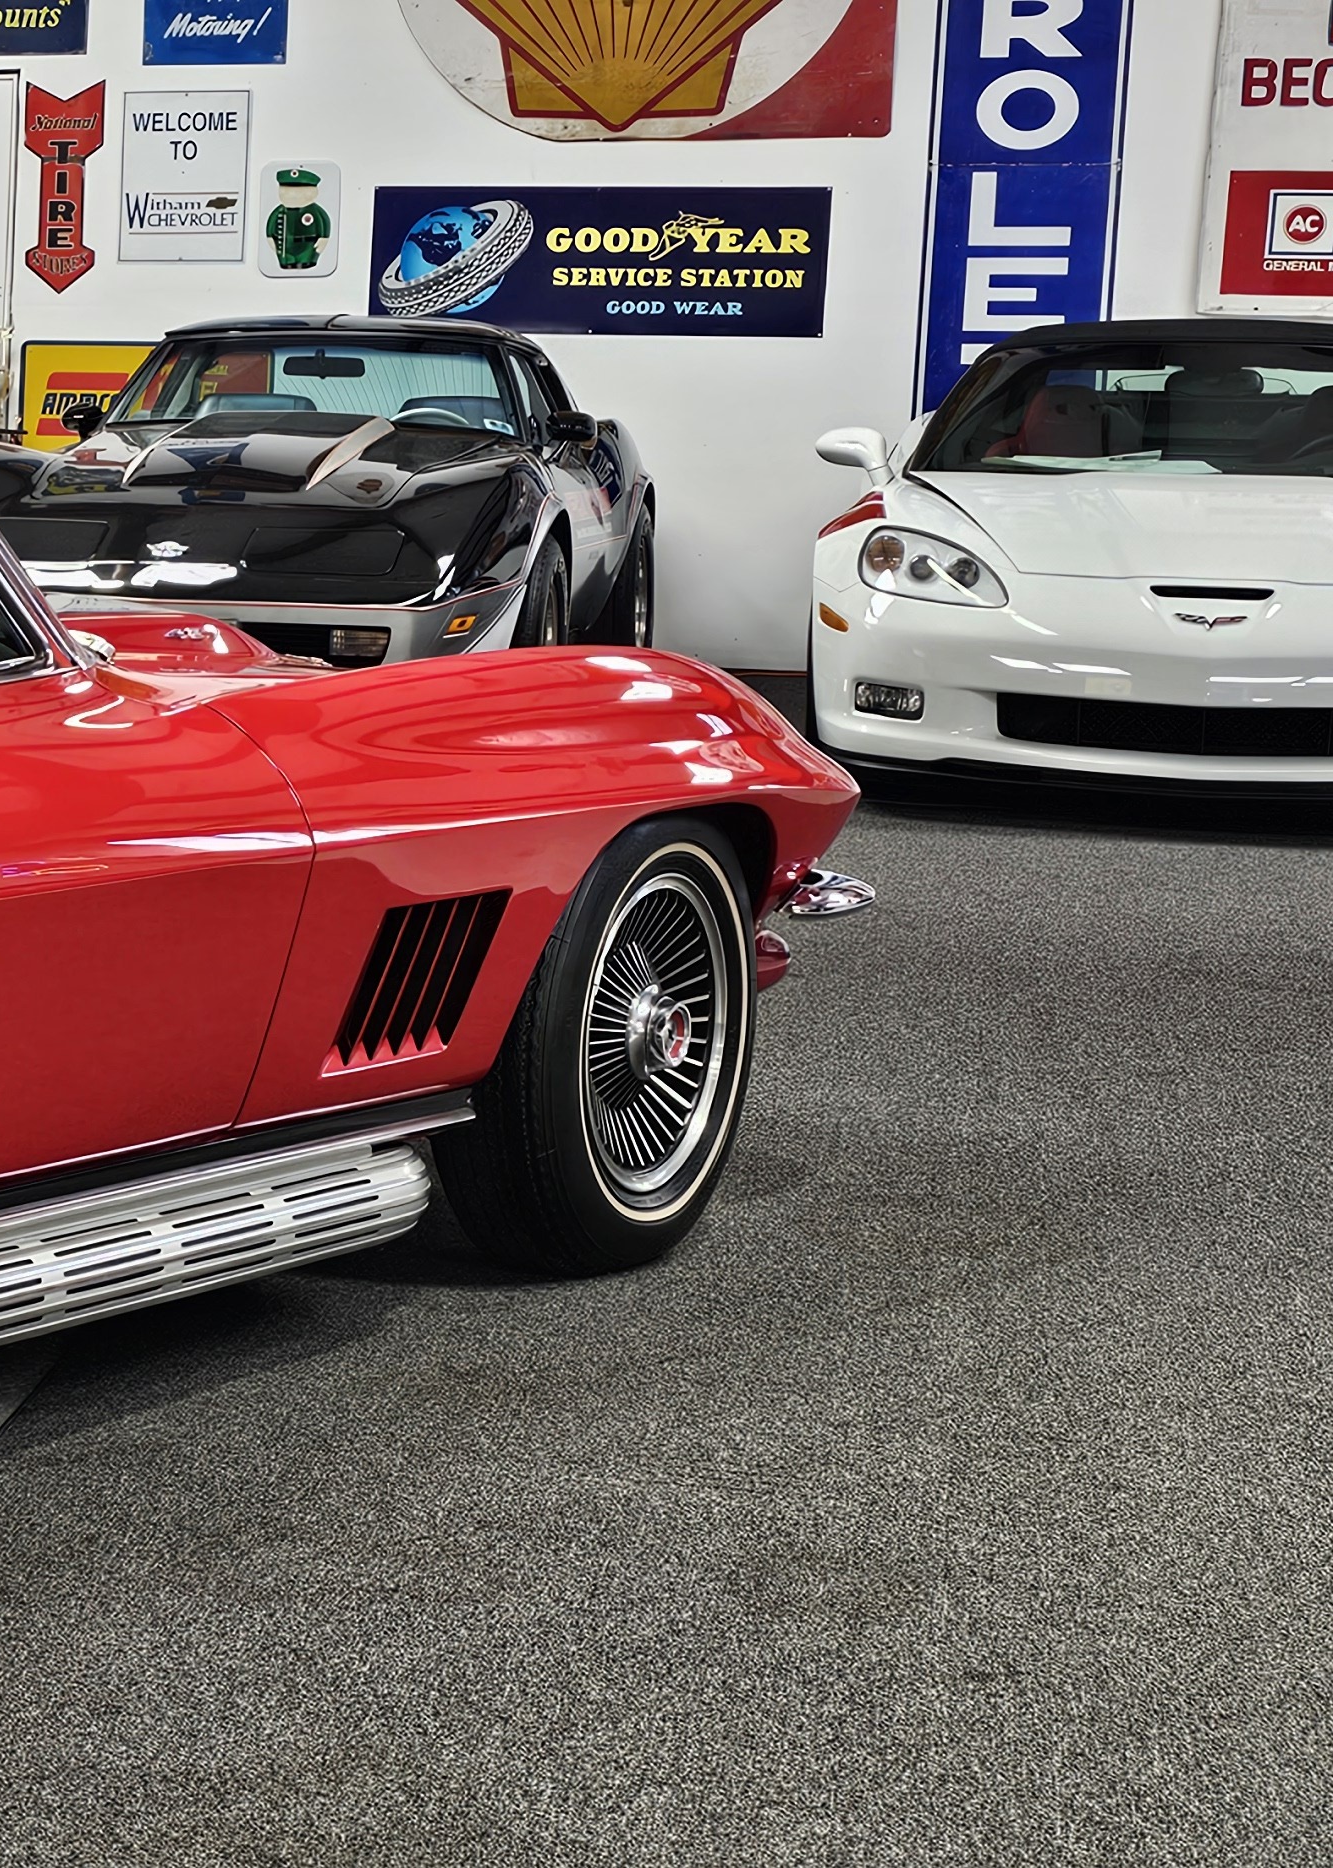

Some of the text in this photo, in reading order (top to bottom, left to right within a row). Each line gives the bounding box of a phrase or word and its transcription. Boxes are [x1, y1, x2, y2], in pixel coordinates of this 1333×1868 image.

[163, 7, 272, 43] Motoring!
[29, 113, 99, 132] National
[132, 112, 238, 132] WELCOME
[170, 140, 198, 160] TO
[960, 0, 1083, 364] ROLE
[46, 139, 78, 249] TIRE
[126, 192, 201, 229] Witham
[148, 212, 239, 227] CHEVROLET
[1288, 214, 1320, 233] AC
[32, 249, 88, 275] STORES
[1263, 260, 1325, 272] GENERAL
[552, 267, 806, 288] SERVICE STATION
[606, 301, 743, 316] GOOD WEAR
